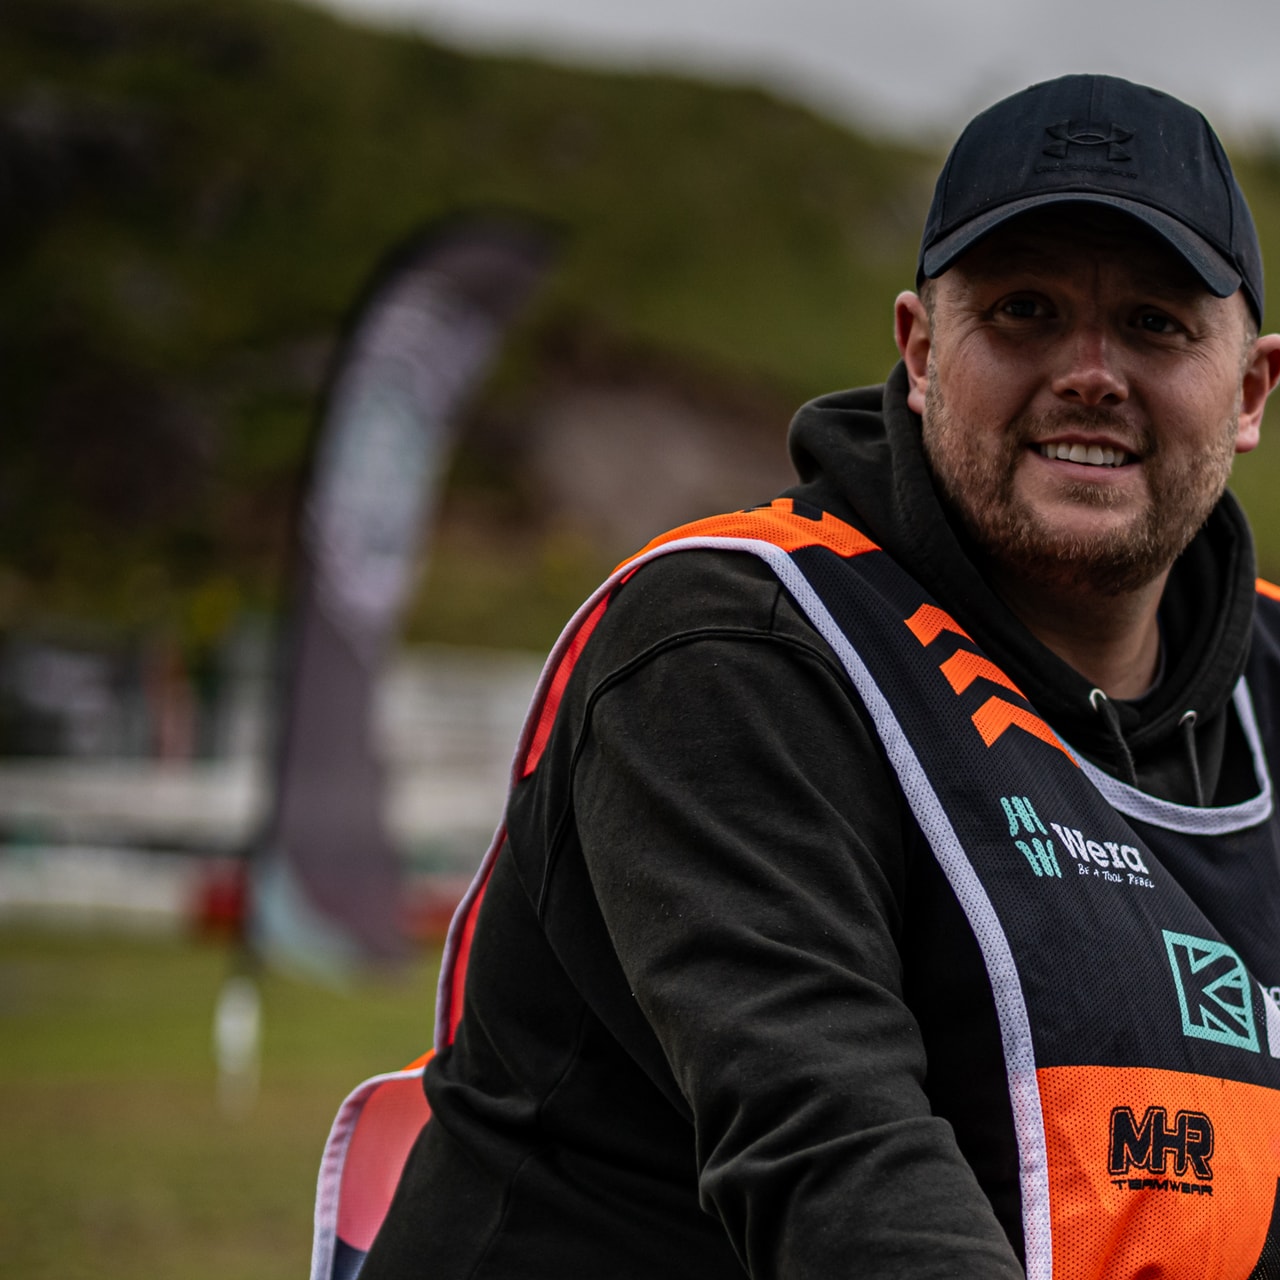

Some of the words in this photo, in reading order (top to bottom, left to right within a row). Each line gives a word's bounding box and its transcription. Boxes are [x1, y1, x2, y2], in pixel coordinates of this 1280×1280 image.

[1050, 822, 1149, 874] Wera
[1107, 1105, 1215, 1180] MHR
[1110, 1178, 1214, 1197] TEAMWEAR
